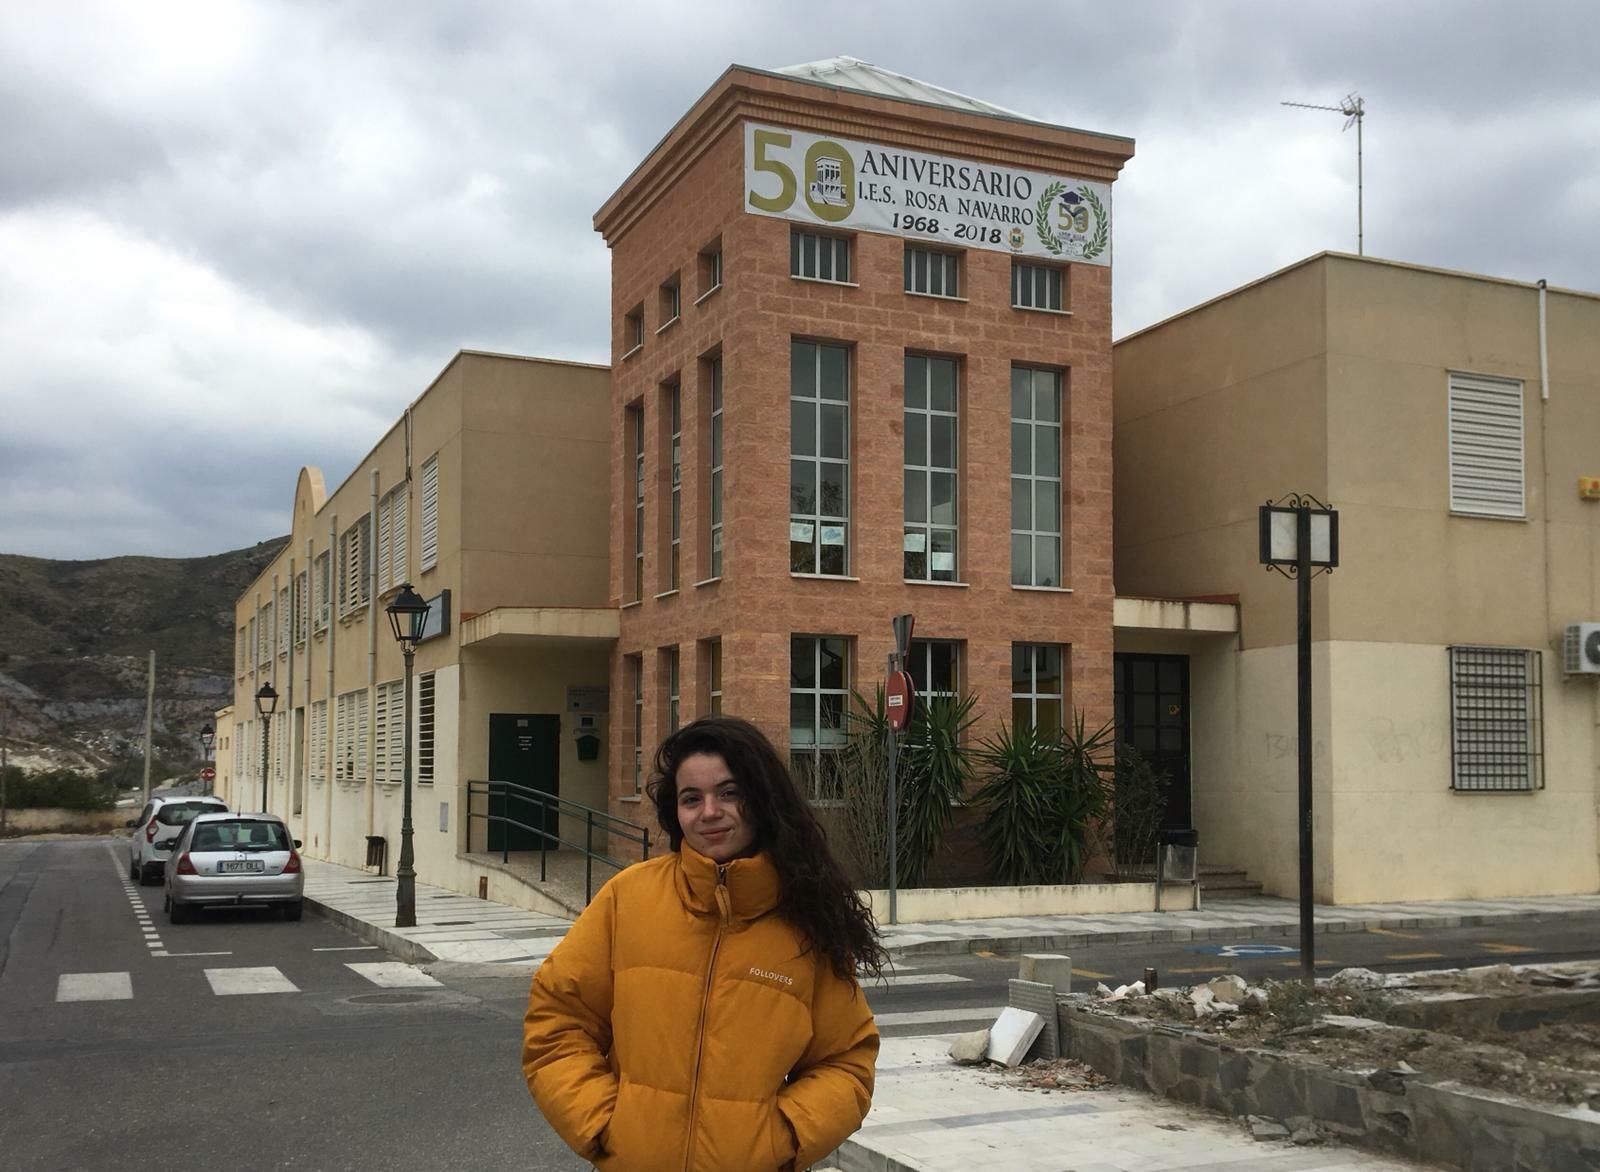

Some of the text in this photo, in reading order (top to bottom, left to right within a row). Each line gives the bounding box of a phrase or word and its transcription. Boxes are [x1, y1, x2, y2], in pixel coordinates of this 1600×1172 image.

[749, 129, 856, 222] 50
[860, 150, 1032, 200] ANIVERSARIO
[858, 181, 1034, 226] I.E.S. ROSA NAVARRO
[893, 213, 939, 234] 1968
[954, 223, 1002, 244] 2018
[750, 967, 793, 985] FOLLOVERS
